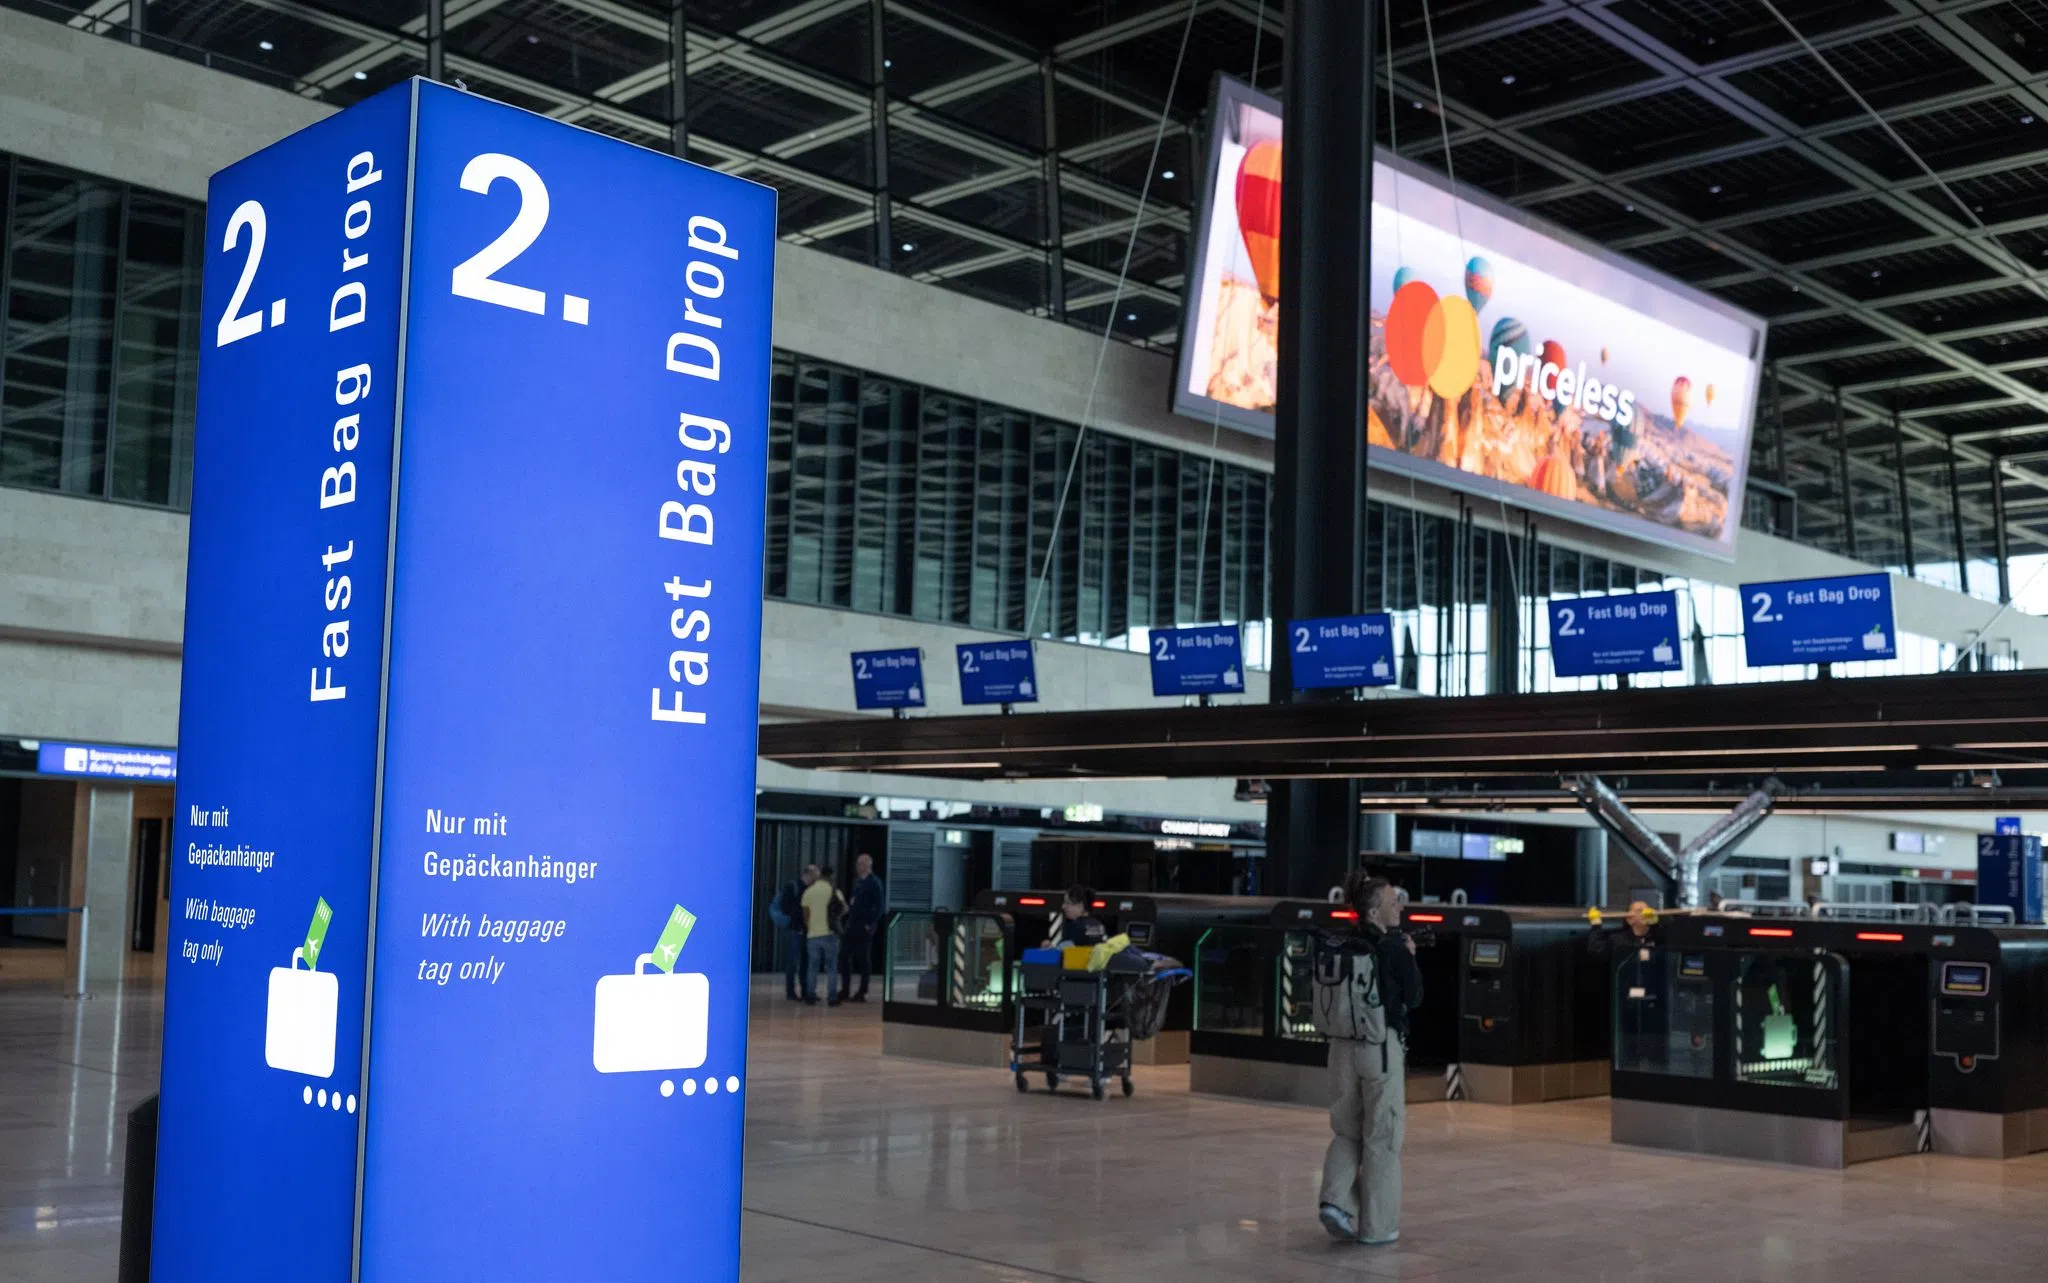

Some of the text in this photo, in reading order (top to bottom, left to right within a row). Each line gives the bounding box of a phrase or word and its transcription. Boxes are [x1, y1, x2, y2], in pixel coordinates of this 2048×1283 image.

[451, 152, 589, 326] 2.
[216, 199, 286, 347] 2.
[1492, 343, 1636, 427] priceless
[309, 149, 384, 702] Fast Bag Drop
[650, 214, 739, 724] Fast Bag Drop
[1751, 591, 1783, 623] 2.
[1787, 585, 1880, 605] Fast Bag Drop
[1557, 607, 1585, 636] 2.
[1587, 602, 1668, 620] Fast Bag Drop
[1176, 633, 1234, 649] Fast Bag Drop
[1295, 627, 1318, 653] 2.
[1319, 623, 1385, 639] Fast Bag Drop
[962, 651, 980, 673] 2.
[1155, 637, 1176, 661] 2.
[856, 658, 873, 680] 2.
[190, 804, 229, 828] Nur mit
[425, 808, 508, 837] Nur mit
[188, 842, 275, 874] Gepäckanhänger
[423, 851, 598, 885] Gepäckanhänger
[185, 897, 256, 928] With baggage
[420, 912, 566, 944] With baggage
[182, 938, 223, 967] tag only
[417, 955, 505, 985] tag only
